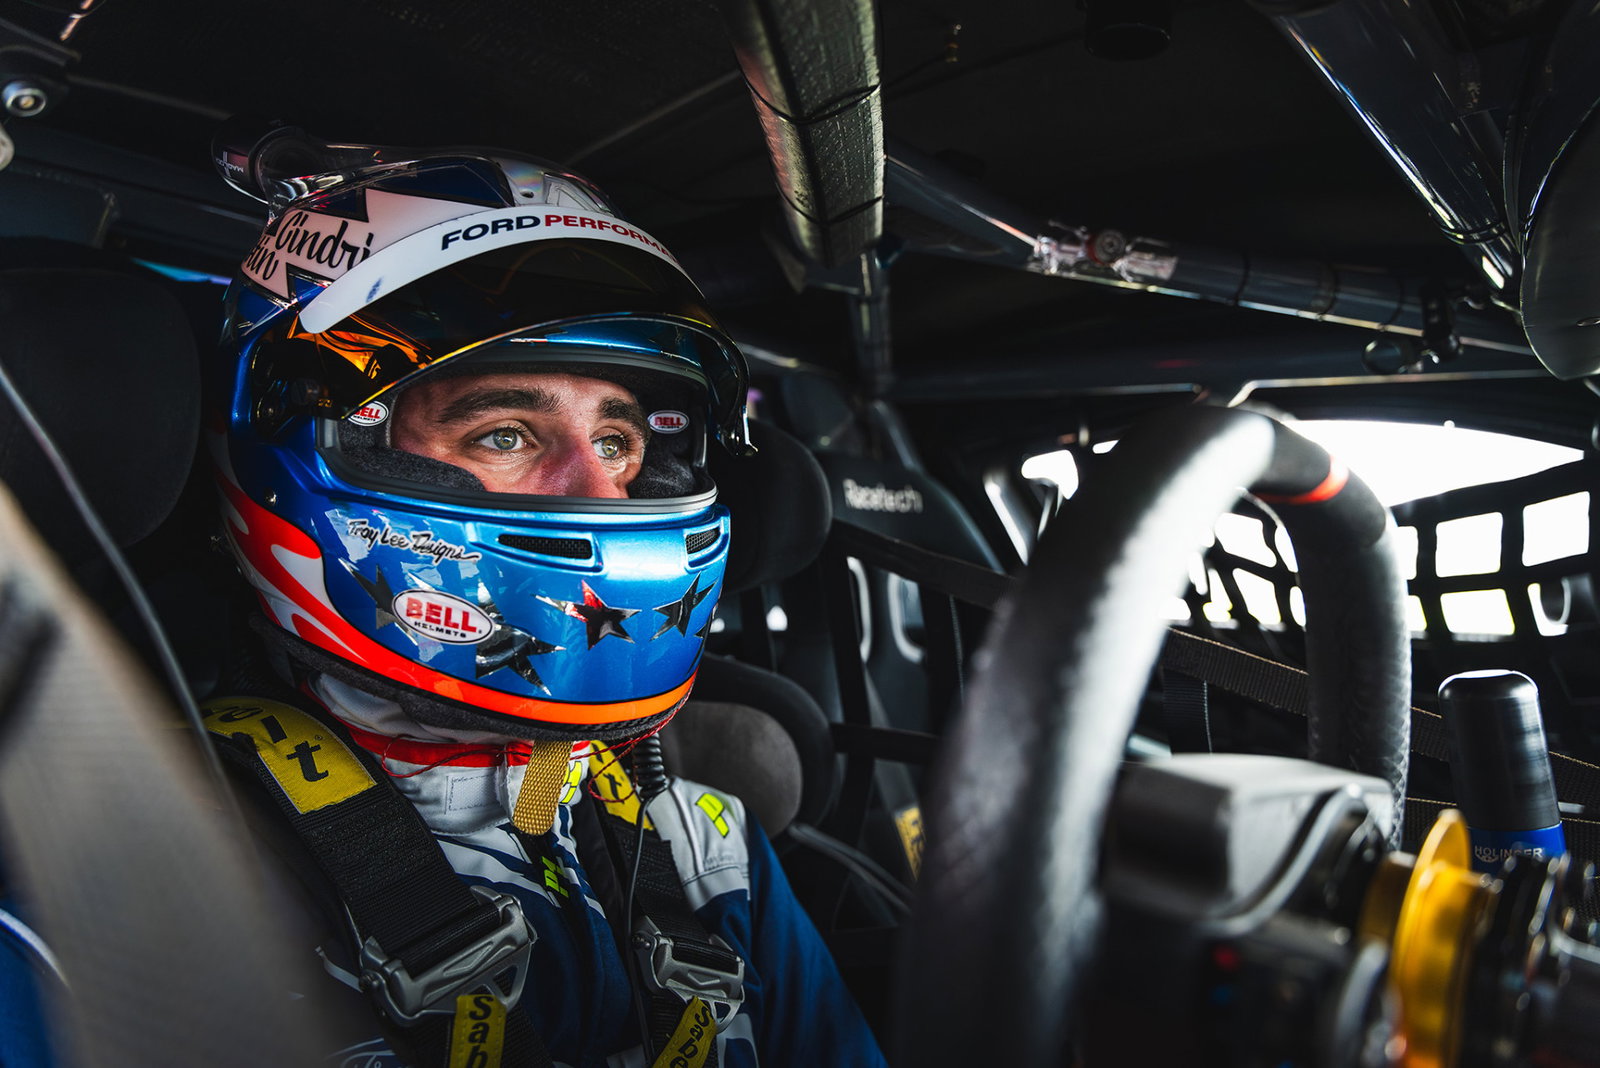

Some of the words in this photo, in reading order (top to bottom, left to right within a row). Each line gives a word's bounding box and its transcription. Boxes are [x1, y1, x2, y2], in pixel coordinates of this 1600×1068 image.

[441, 214, 541, 250] FORD
[654, 416, 683, 426] BELL
[349, 519, 379, 548] Troy
[381, 527, 410, 549] Lee
[406, 597, 477, 633] BELL
[414, 621, 467, 639] HELMETS
